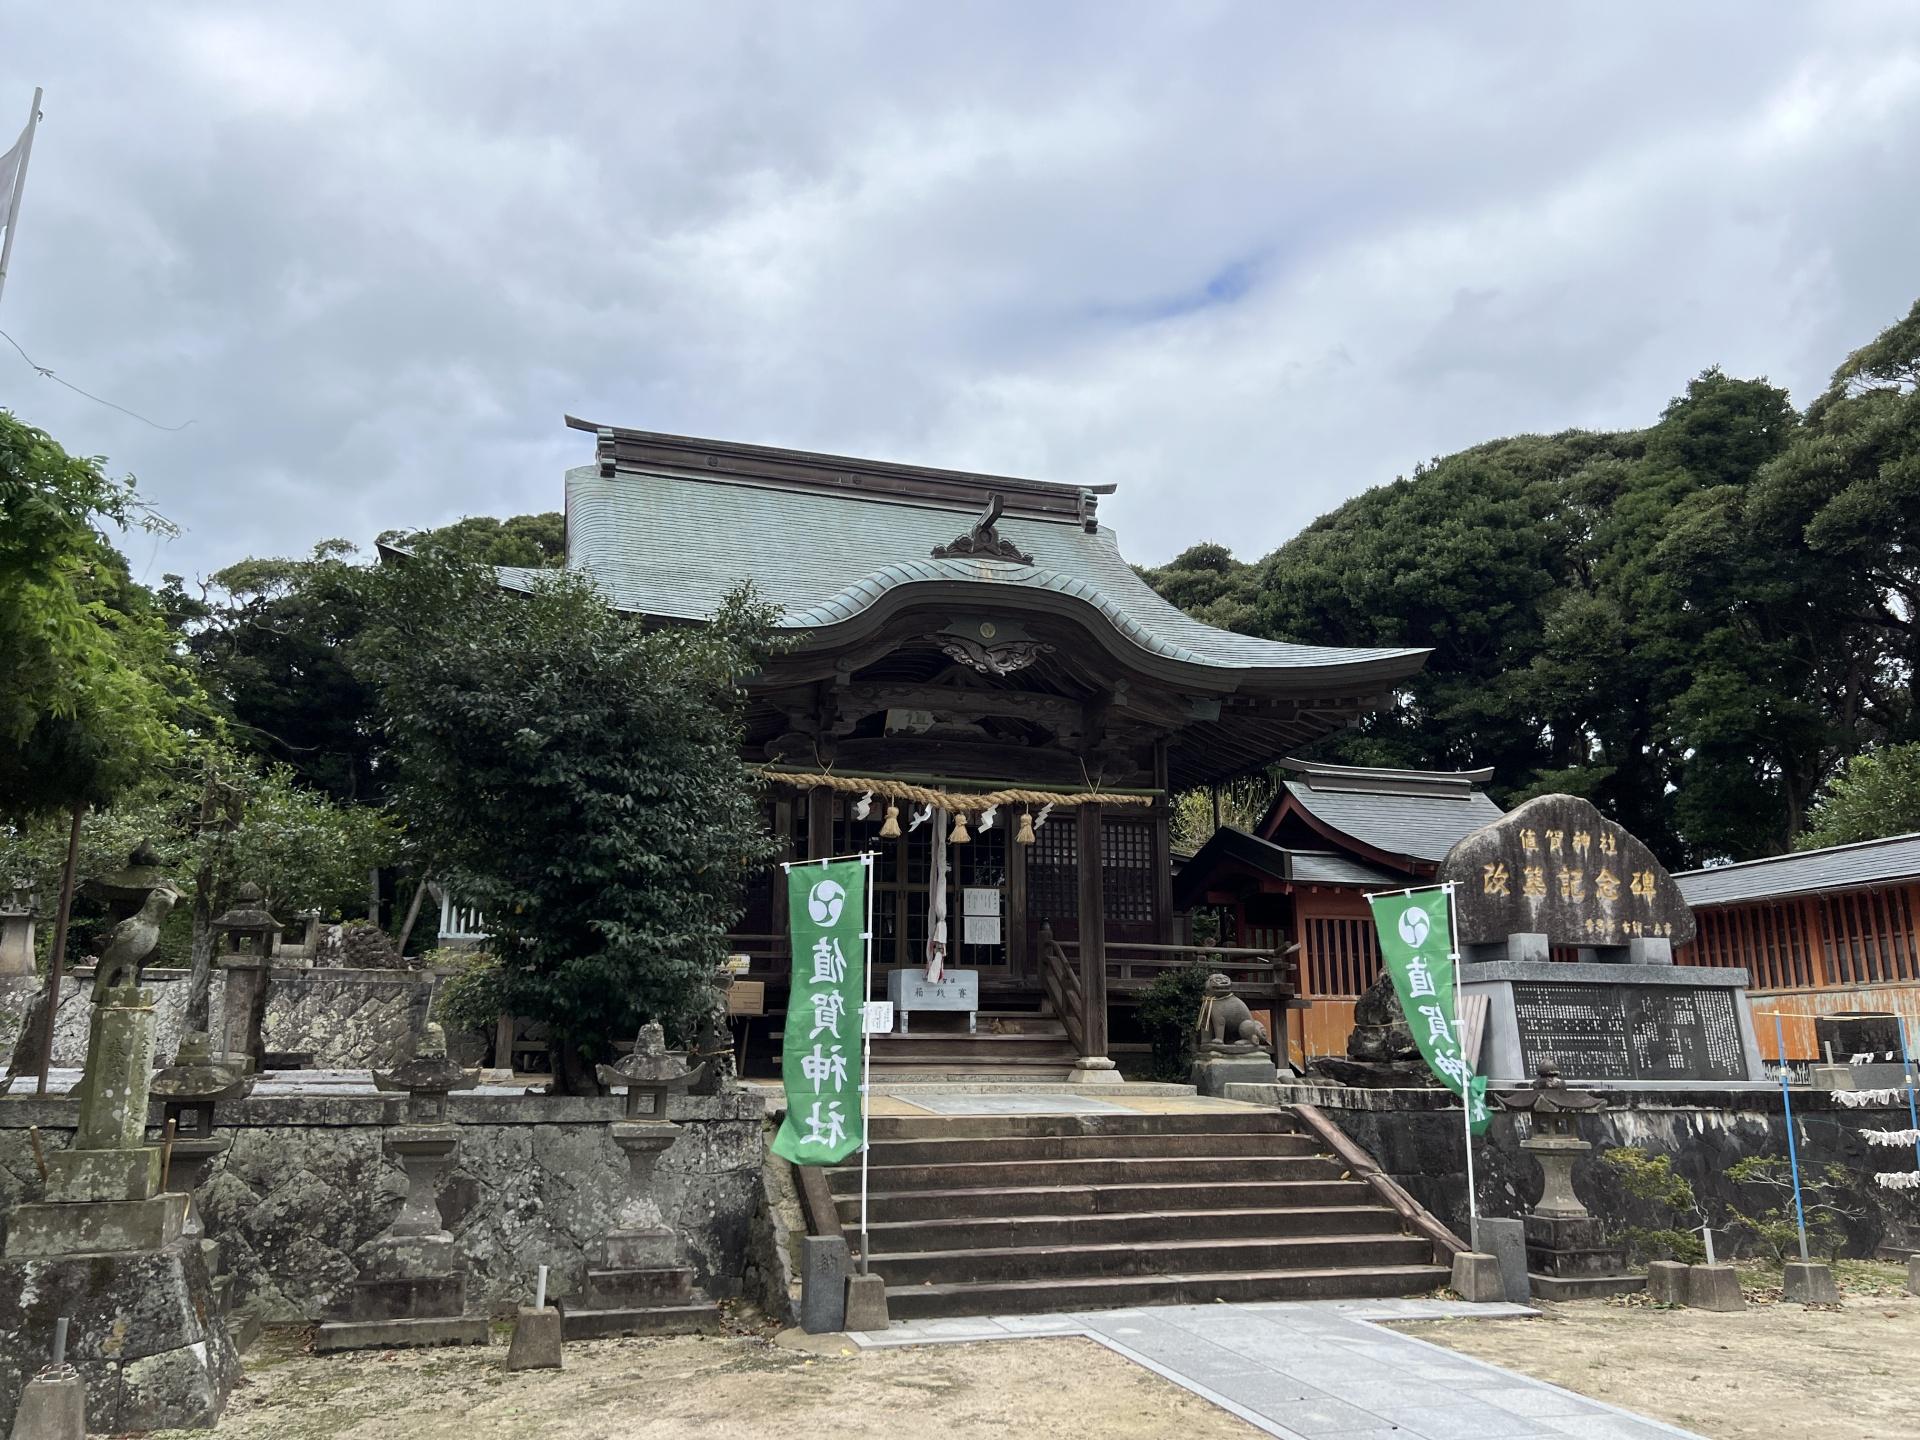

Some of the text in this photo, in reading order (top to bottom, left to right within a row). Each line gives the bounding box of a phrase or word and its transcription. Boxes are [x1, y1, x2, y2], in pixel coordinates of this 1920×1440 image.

[1519, 827, 1618, 855] 値賀神社
[1483, 861, 1657, 903] 改築記念碑
